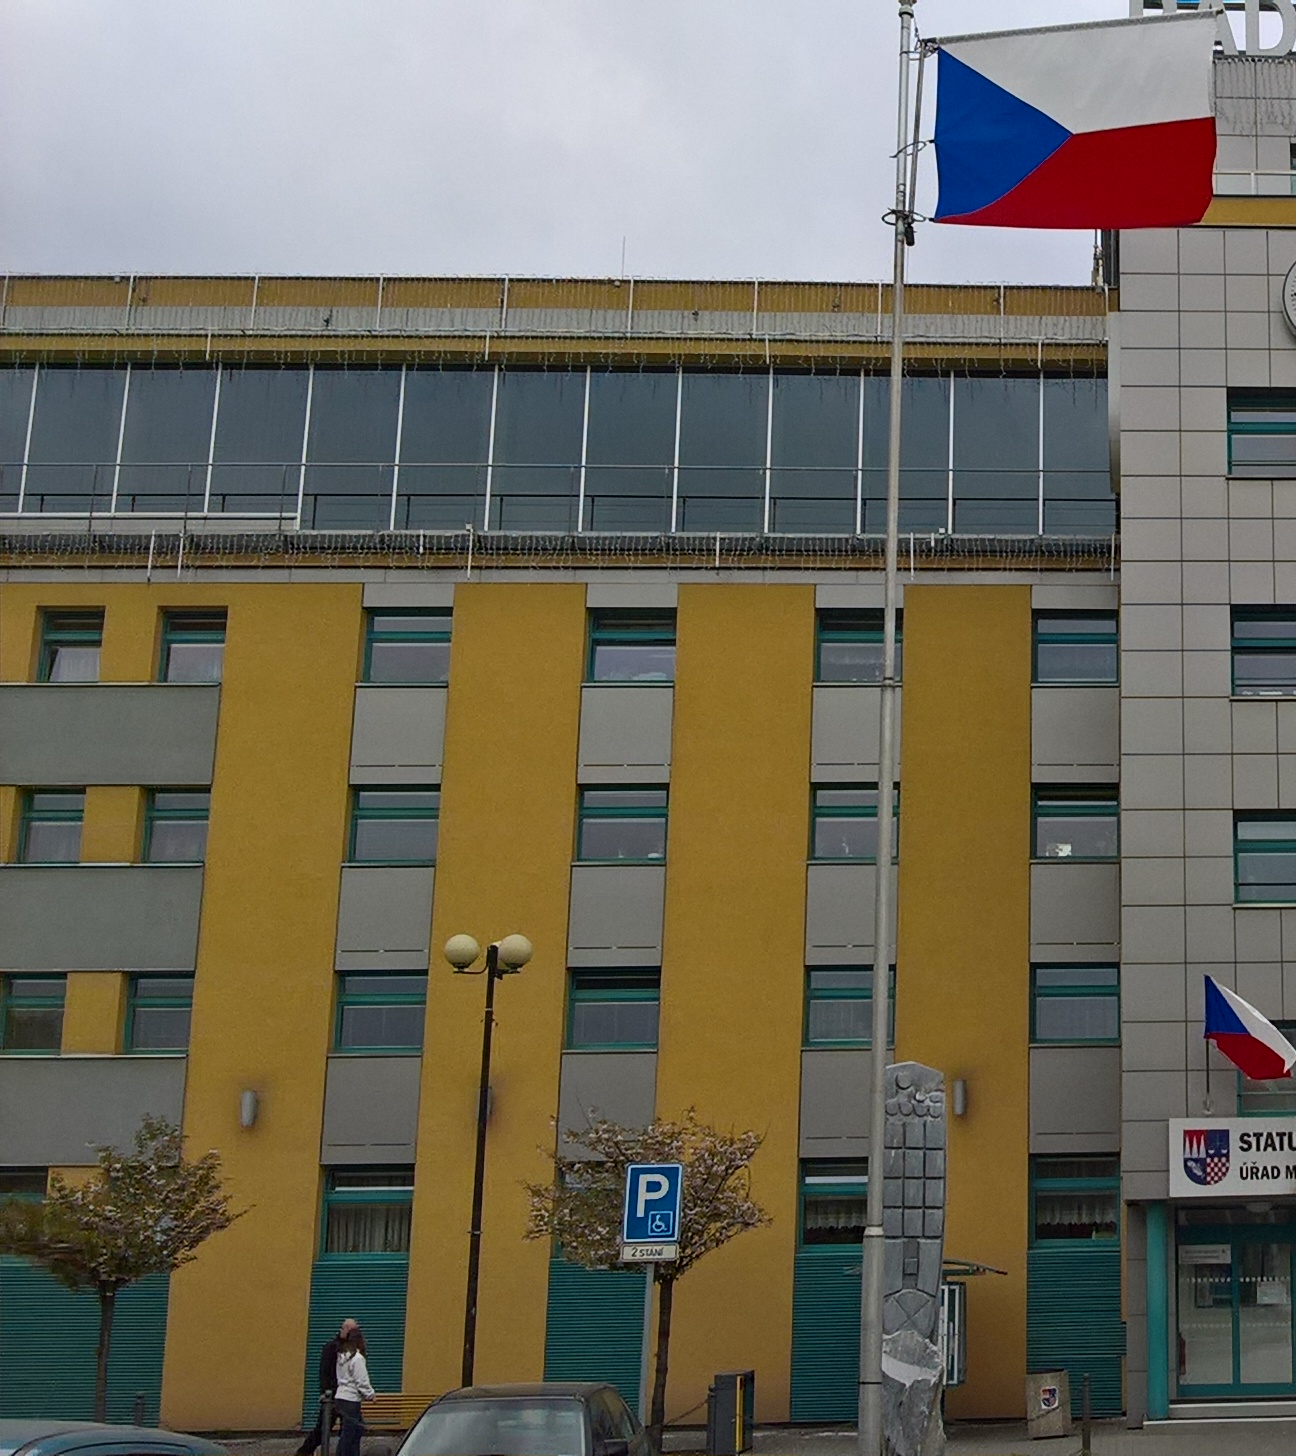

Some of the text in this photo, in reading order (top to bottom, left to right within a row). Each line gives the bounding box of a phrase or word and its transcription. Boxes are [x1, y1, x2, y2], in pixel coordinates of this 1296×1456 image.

[1240, 1162, 1281, 1180] ÚŘAD
[637, 1174, 669, 1217] P
[632, 1247, 638, 1257] 2
